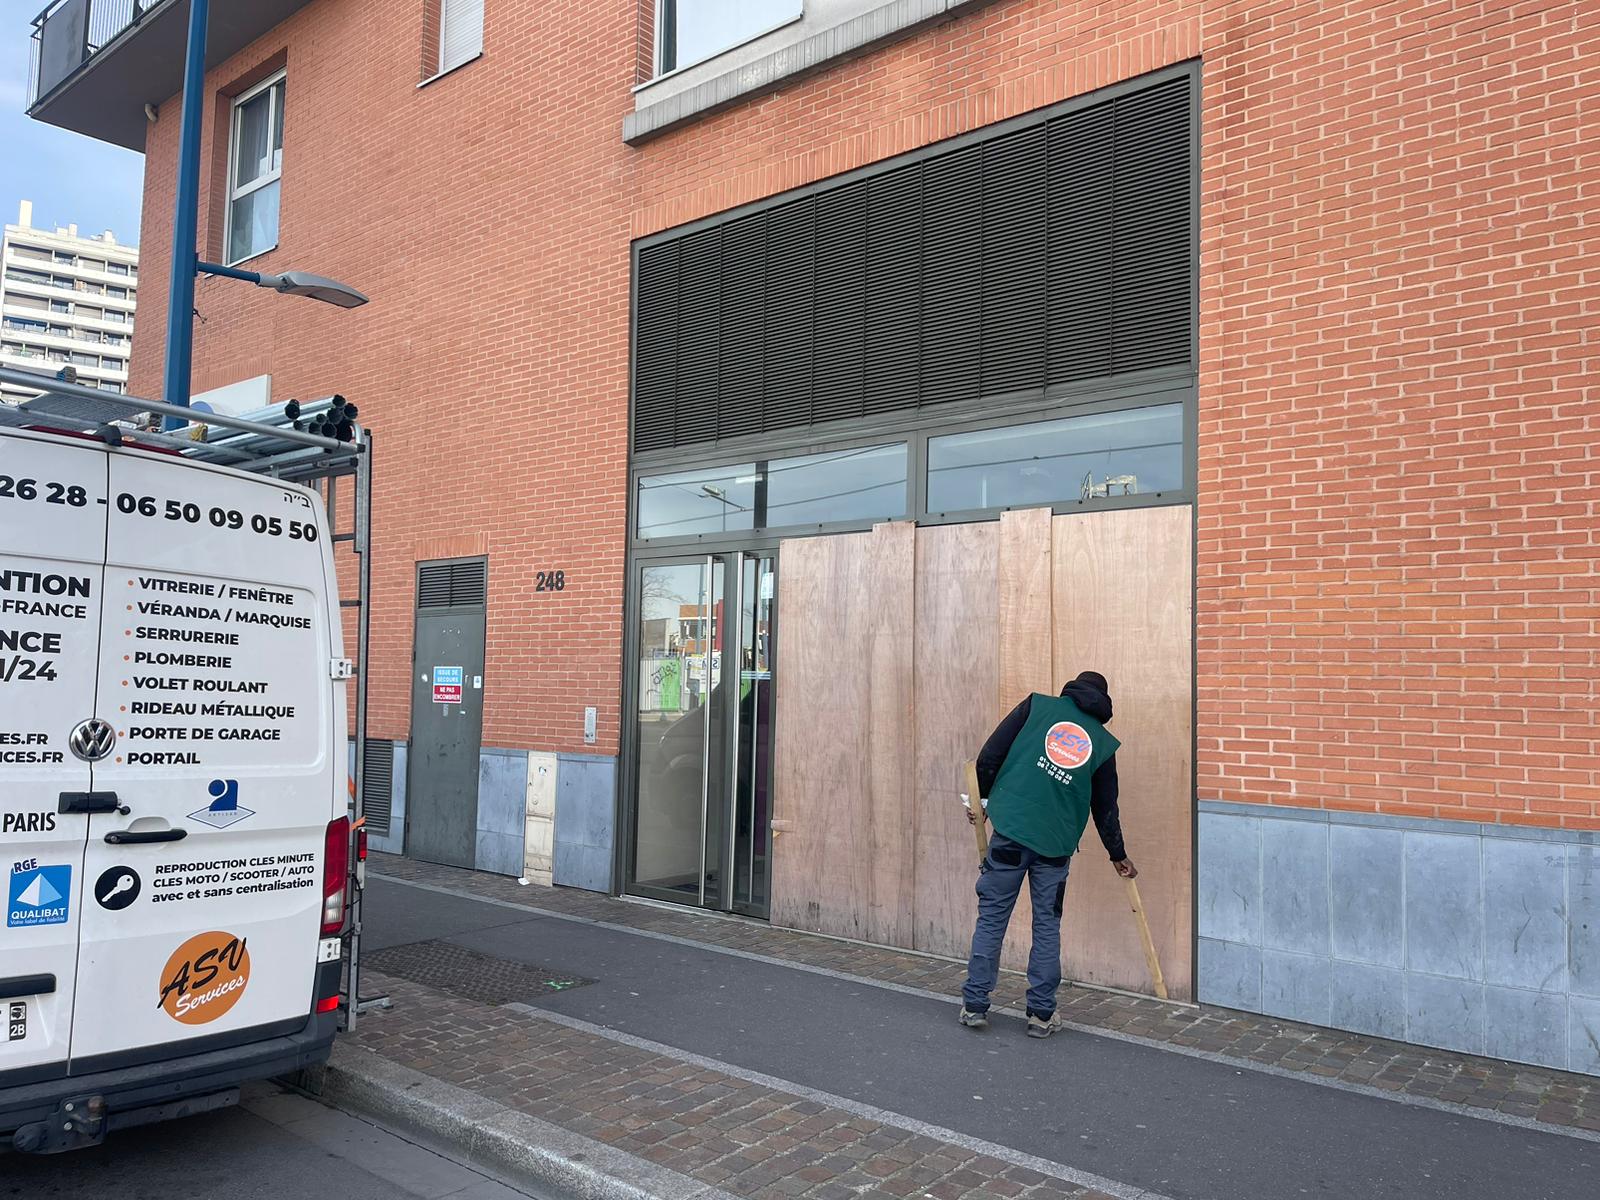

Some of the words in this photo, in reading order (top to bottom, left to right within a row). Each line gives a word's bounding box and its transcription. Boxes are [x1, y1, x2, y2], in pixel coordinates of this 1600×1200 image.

[0, 474, 38, 500] 26
[45, 482, 87, 507] 28
[116, 492, 157, 517] 06
[164, 500, 201, 523] 50
[208, 507, 244, 529] 09
[251, 514, 283, 536] 05
[288, 520, 318, 542] 50
[138, 577, 215, 596] VITRERIE
[217, 584, 226, 598] /
[228, 587, 294, 605] FENÊTRE
[535, 570, 565, 592] 248
[0, 599, 87, 619] FRANCE
[137, 600, 221, 620] VÉRANDA
[224, 608, 233, 622] /
[235, 610, 311, 629] MARQUISE
[0, 630, 61, 653] NCE
[135, 626, 239, 645] SERRURERIE
[134, 651, 232, 668] PLOMBERIE
[133, 676, 189, 691] VOLET
[193, 679, 268, 694] ROULANT
[131, 701, 197, 715] RIDEAU
[201, 700, 295, 720] MÉTALLIQUE
[0, 733, 48, 745] ES.FR
[129, 727, 187, 740] PORTE
[191, 728, 214, 740] DE
[218, 728, 281, 740] GARAGE
[127, 752, 201, 765] PORTAIL
[3, 812, 56, 832] PARIS
[13, 858, 38, 872] RGE
[155, 859, 247, 874] REPRODUCTION
[249, 856, 275, 866] CLES
[277, 853, 314, 864] MINUTE
[153, 877, 183, 888] CLES
[185, 874, 220, 885] MOTO
[222, 872, 229, 883] /
[230, 869, 279, 881] SCOOTER
[281, 866, 287, 877] /
[288, 865, 315, 876] AUTO
[152, 892, 184, 903] avec
[187, 889, 201, 899] et
[203, 887, 233, 898] sans
[236, 878, 314, 895] centralisation
[11, 907, 66, 920] QUALIBAT
[157, 937, 247, 1009] ASV
[175, 975, 246, 1017] Services
[10, 1024, 25, 1037] 2B
